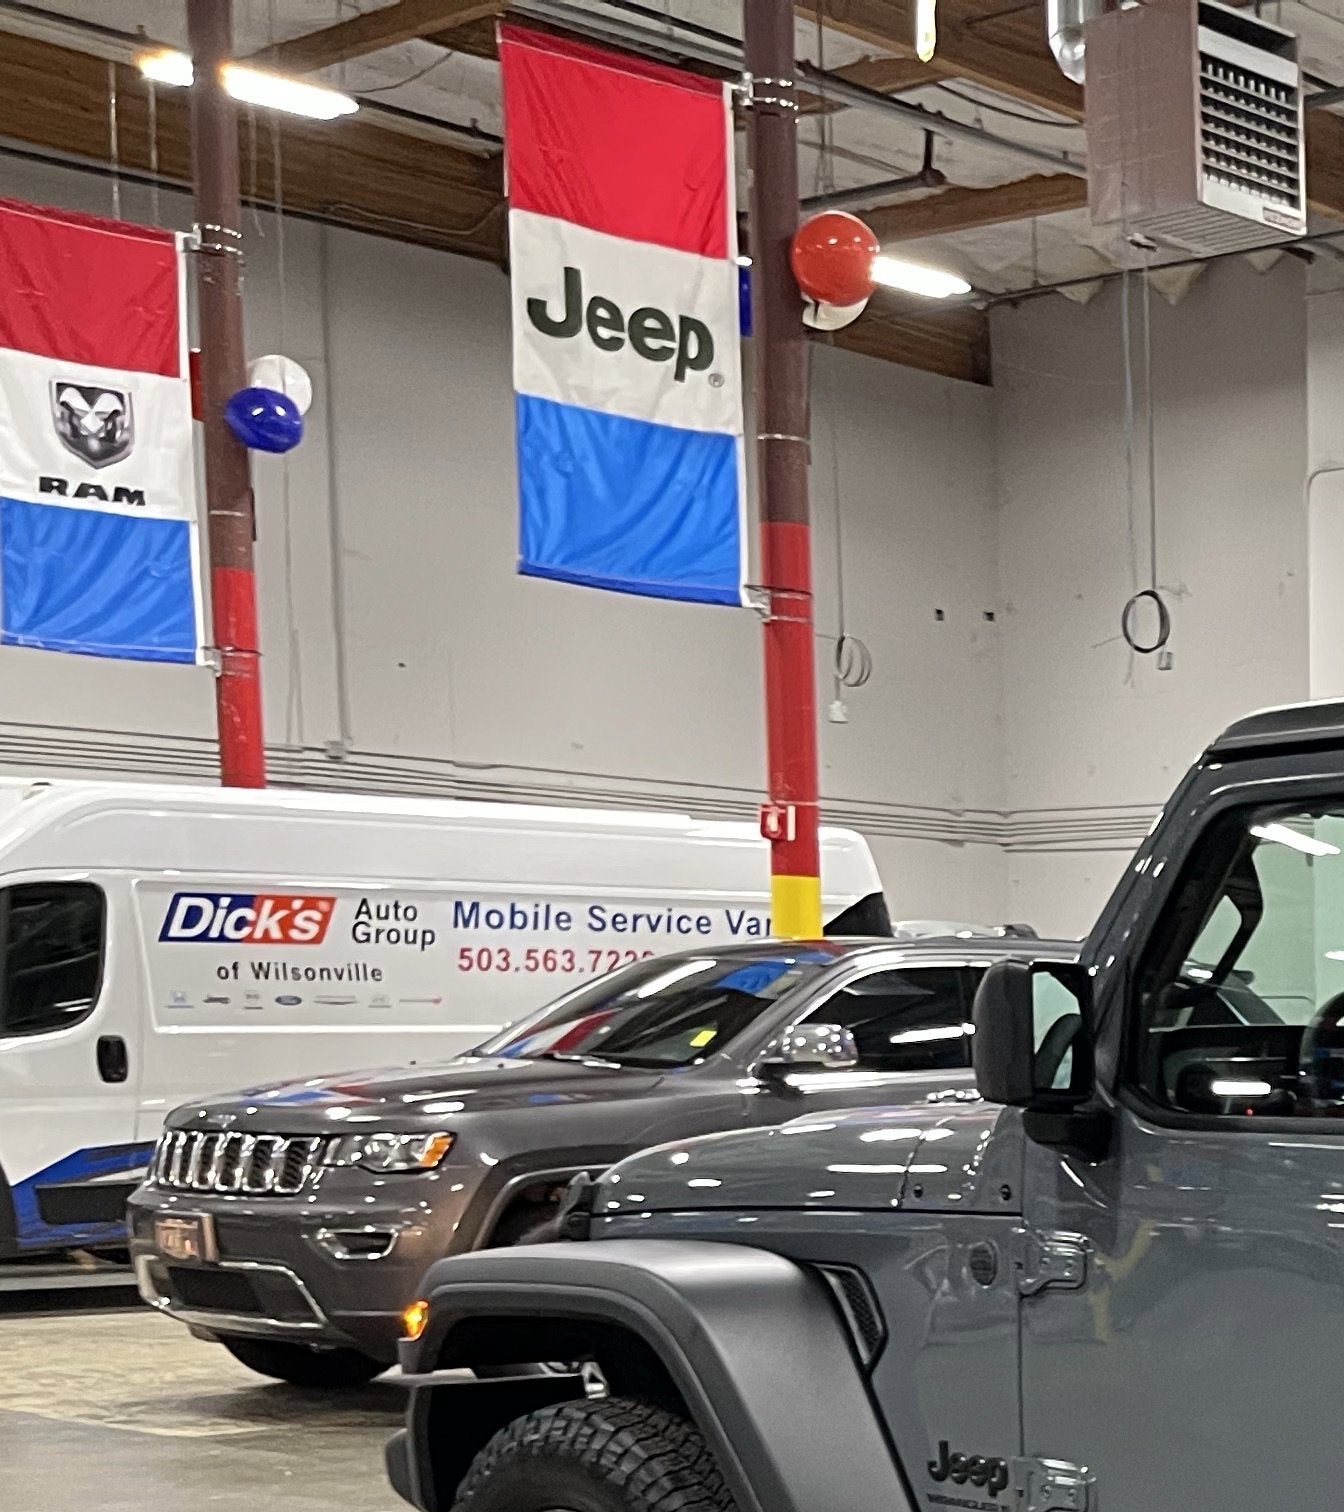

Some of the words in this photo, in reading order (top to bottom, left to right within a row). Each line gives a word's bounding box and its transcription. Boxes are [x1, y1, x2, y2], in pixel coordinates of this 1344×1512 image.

[526, 265, 715, 383] Jeep
[38, 475, 146, 507] RAM
[354, 897, 418, 922] Auto
[452, 900, 573, 930] Mobile
[587, 904, 712, 936] Service
[351, 920, 436, 951] Group
[216, 961, 240, 981] of
[250, 961, 384, 982] Wilsonville
[927, 1440, 1009, 1498] Jeep
